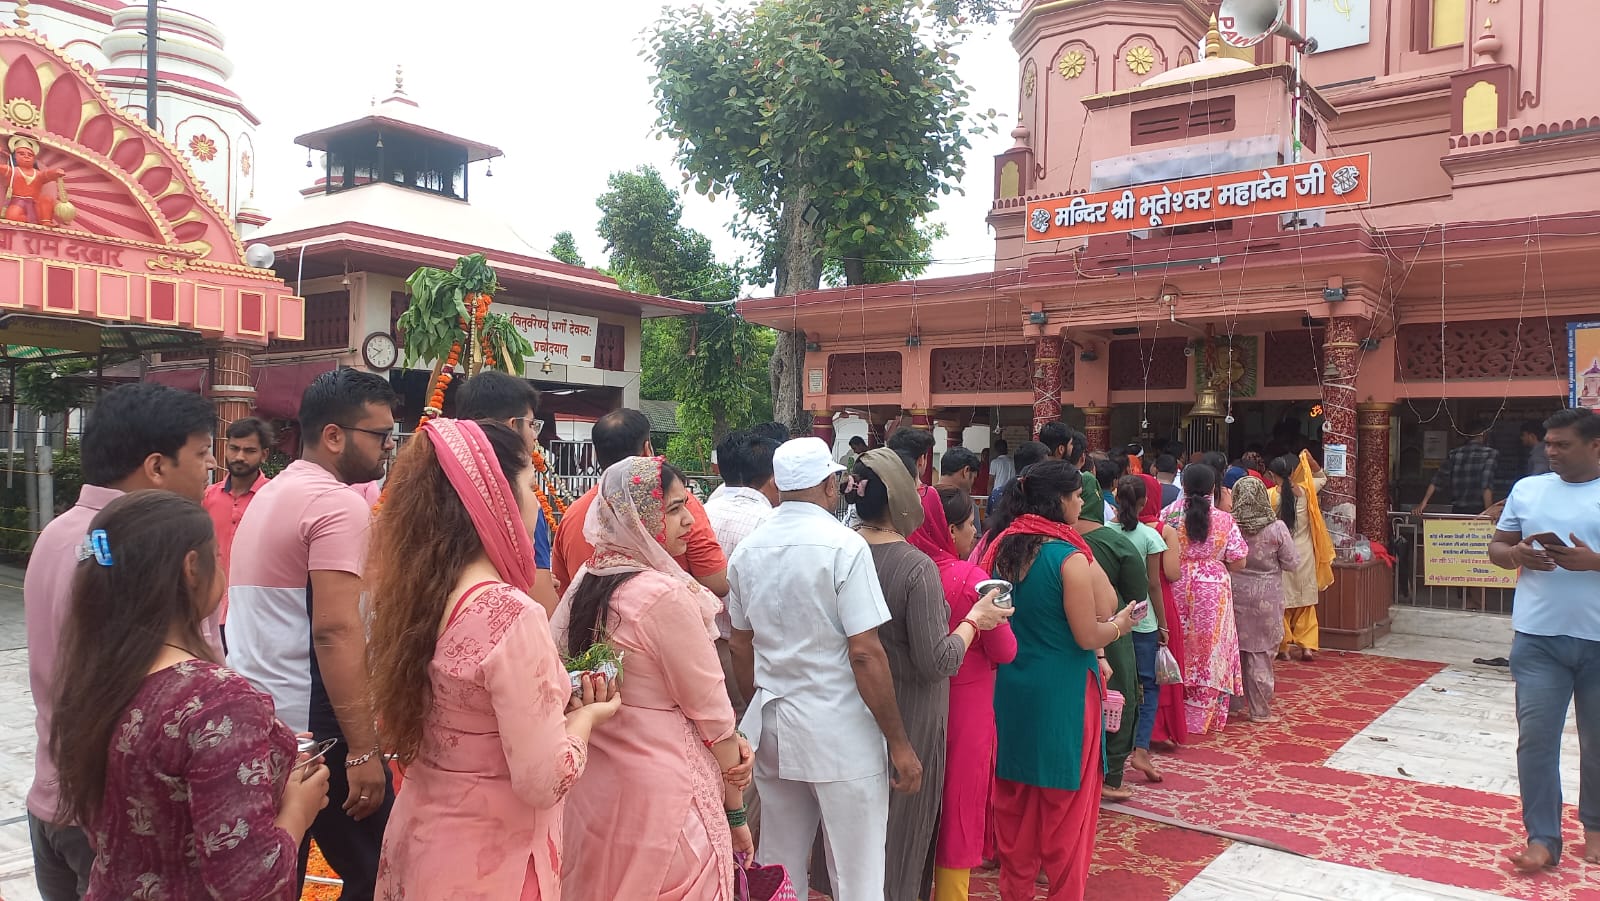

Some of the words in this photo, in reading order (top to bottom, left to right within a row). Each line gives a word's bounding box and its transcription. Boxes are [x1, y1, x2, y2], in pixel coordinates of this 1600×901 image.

[1054, 197, 1109, 227] मन्दिर
[1111, 190, 1136, 220] श्री
[1139, 186, 1213, 227] भूतेश्वर
[1217, 170, 1289, 206] महादेव
[1293, 163, 1327, 197] जी
[22, 234, 61, 257] राम
[65, 241, 124, 267] दरबार
